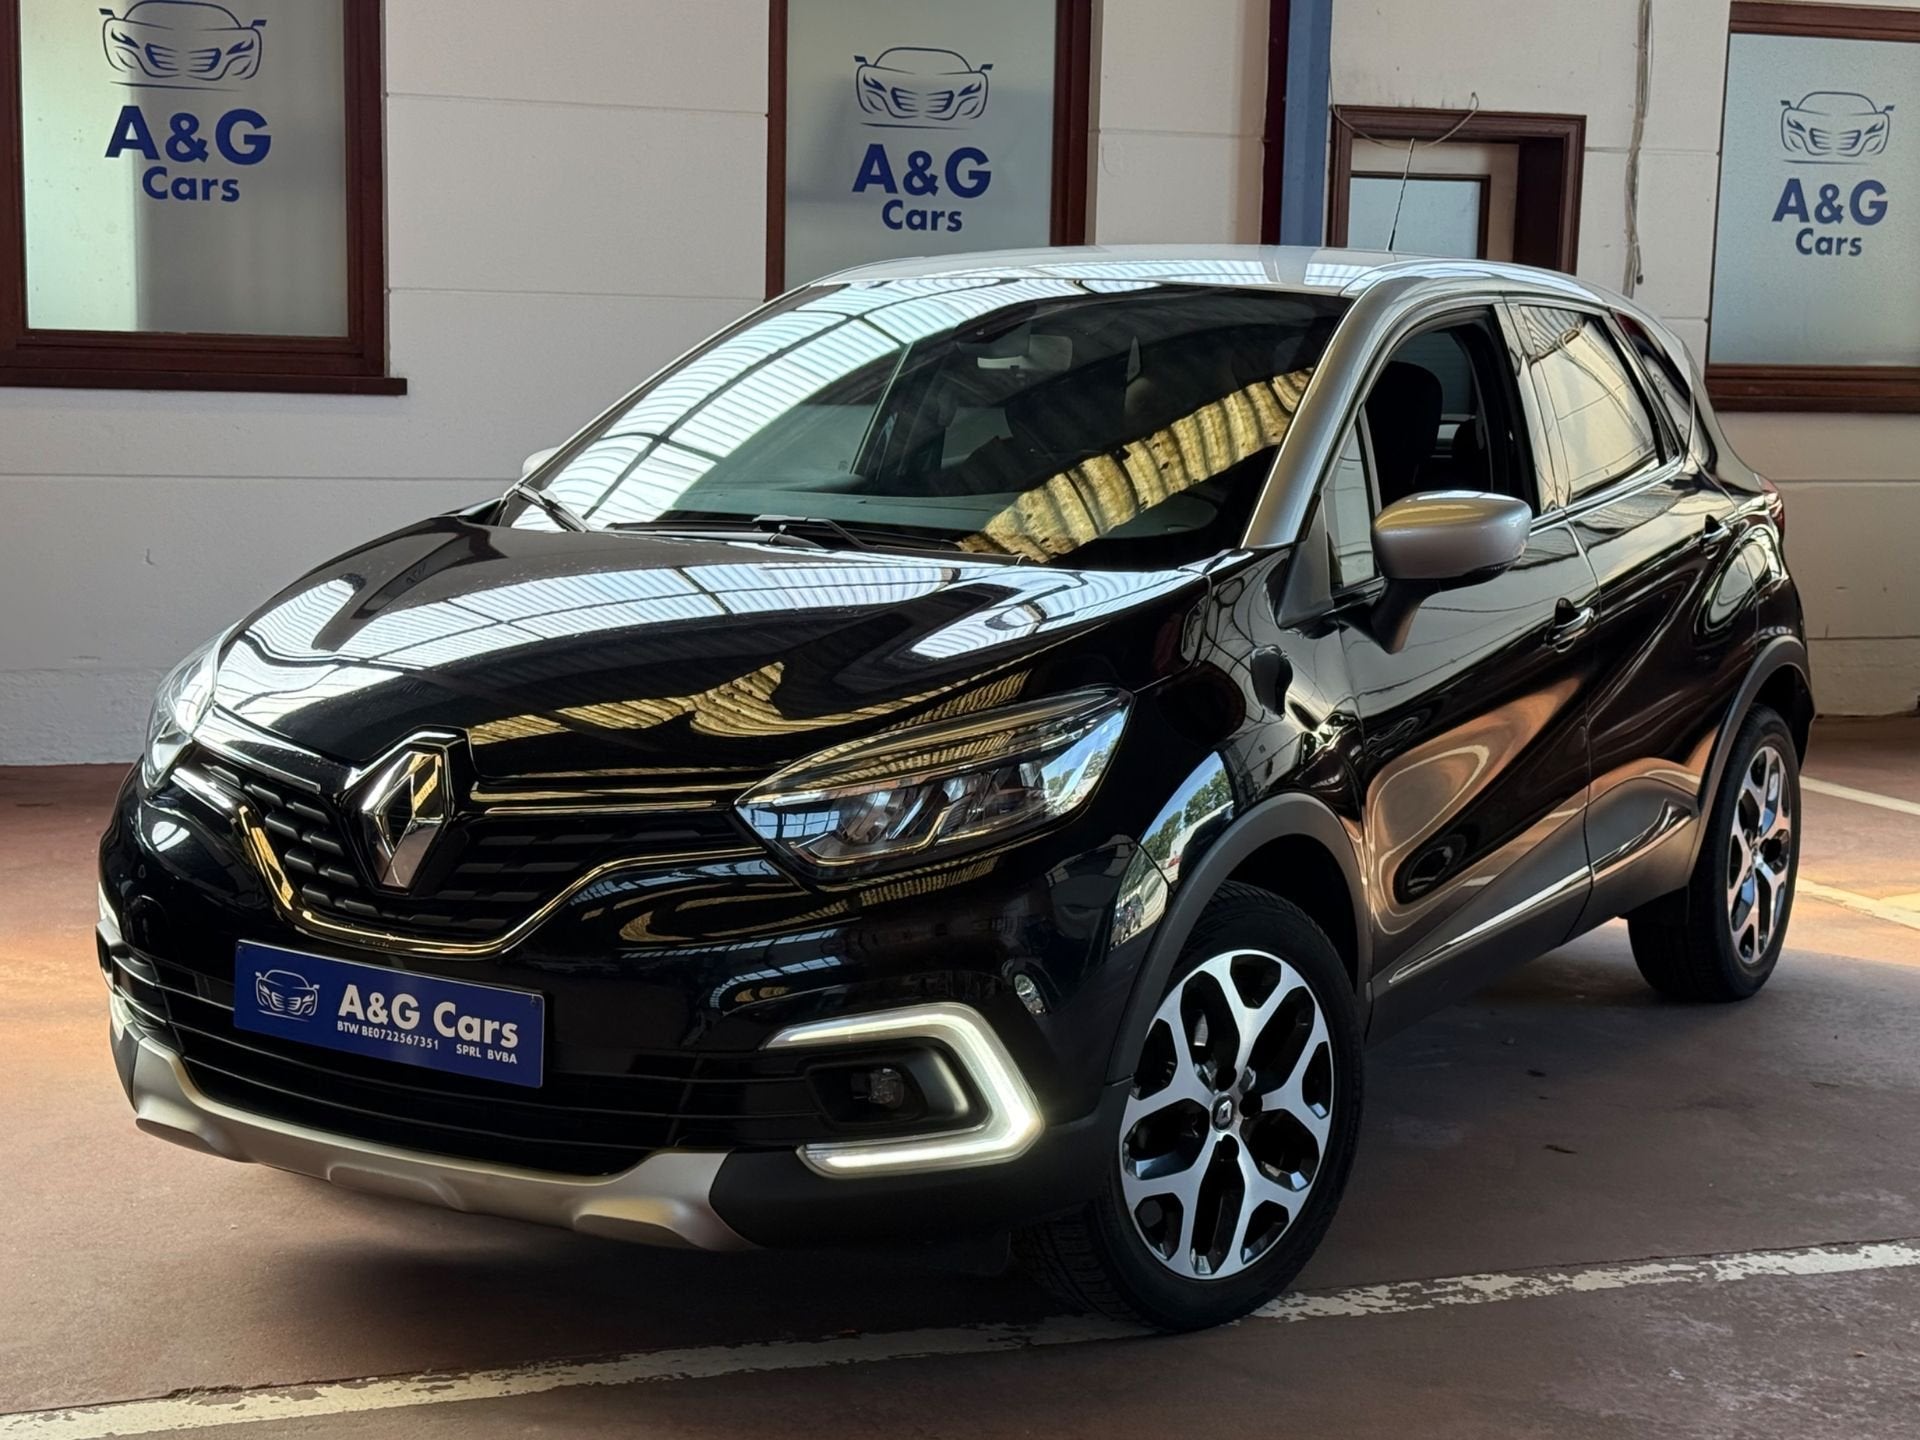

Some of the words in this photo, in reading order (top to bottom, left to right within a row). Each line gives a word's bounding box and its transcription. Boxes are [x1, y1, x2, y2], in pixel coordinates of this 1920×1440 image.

[105, 105, 271, 165] A&G
[142, 166, 240, 202] Cars
[852, 143, 991, 198] A&G
[882, 199, 962, 232] Cars
[1771, 178, 1888, 226] A&G
[1795, 227, 1862, 256] Cars
[338, 984, 420, 1030] A&G
[433, 1001, 518, 1048] Cars
[337, 1021, 359, 1034] BTW
[361, 1025, 438, 1050] BE0722567351
[456, 1043, 481, 1058] SPRL
[487, 1049, 517, 1064] BVBA
